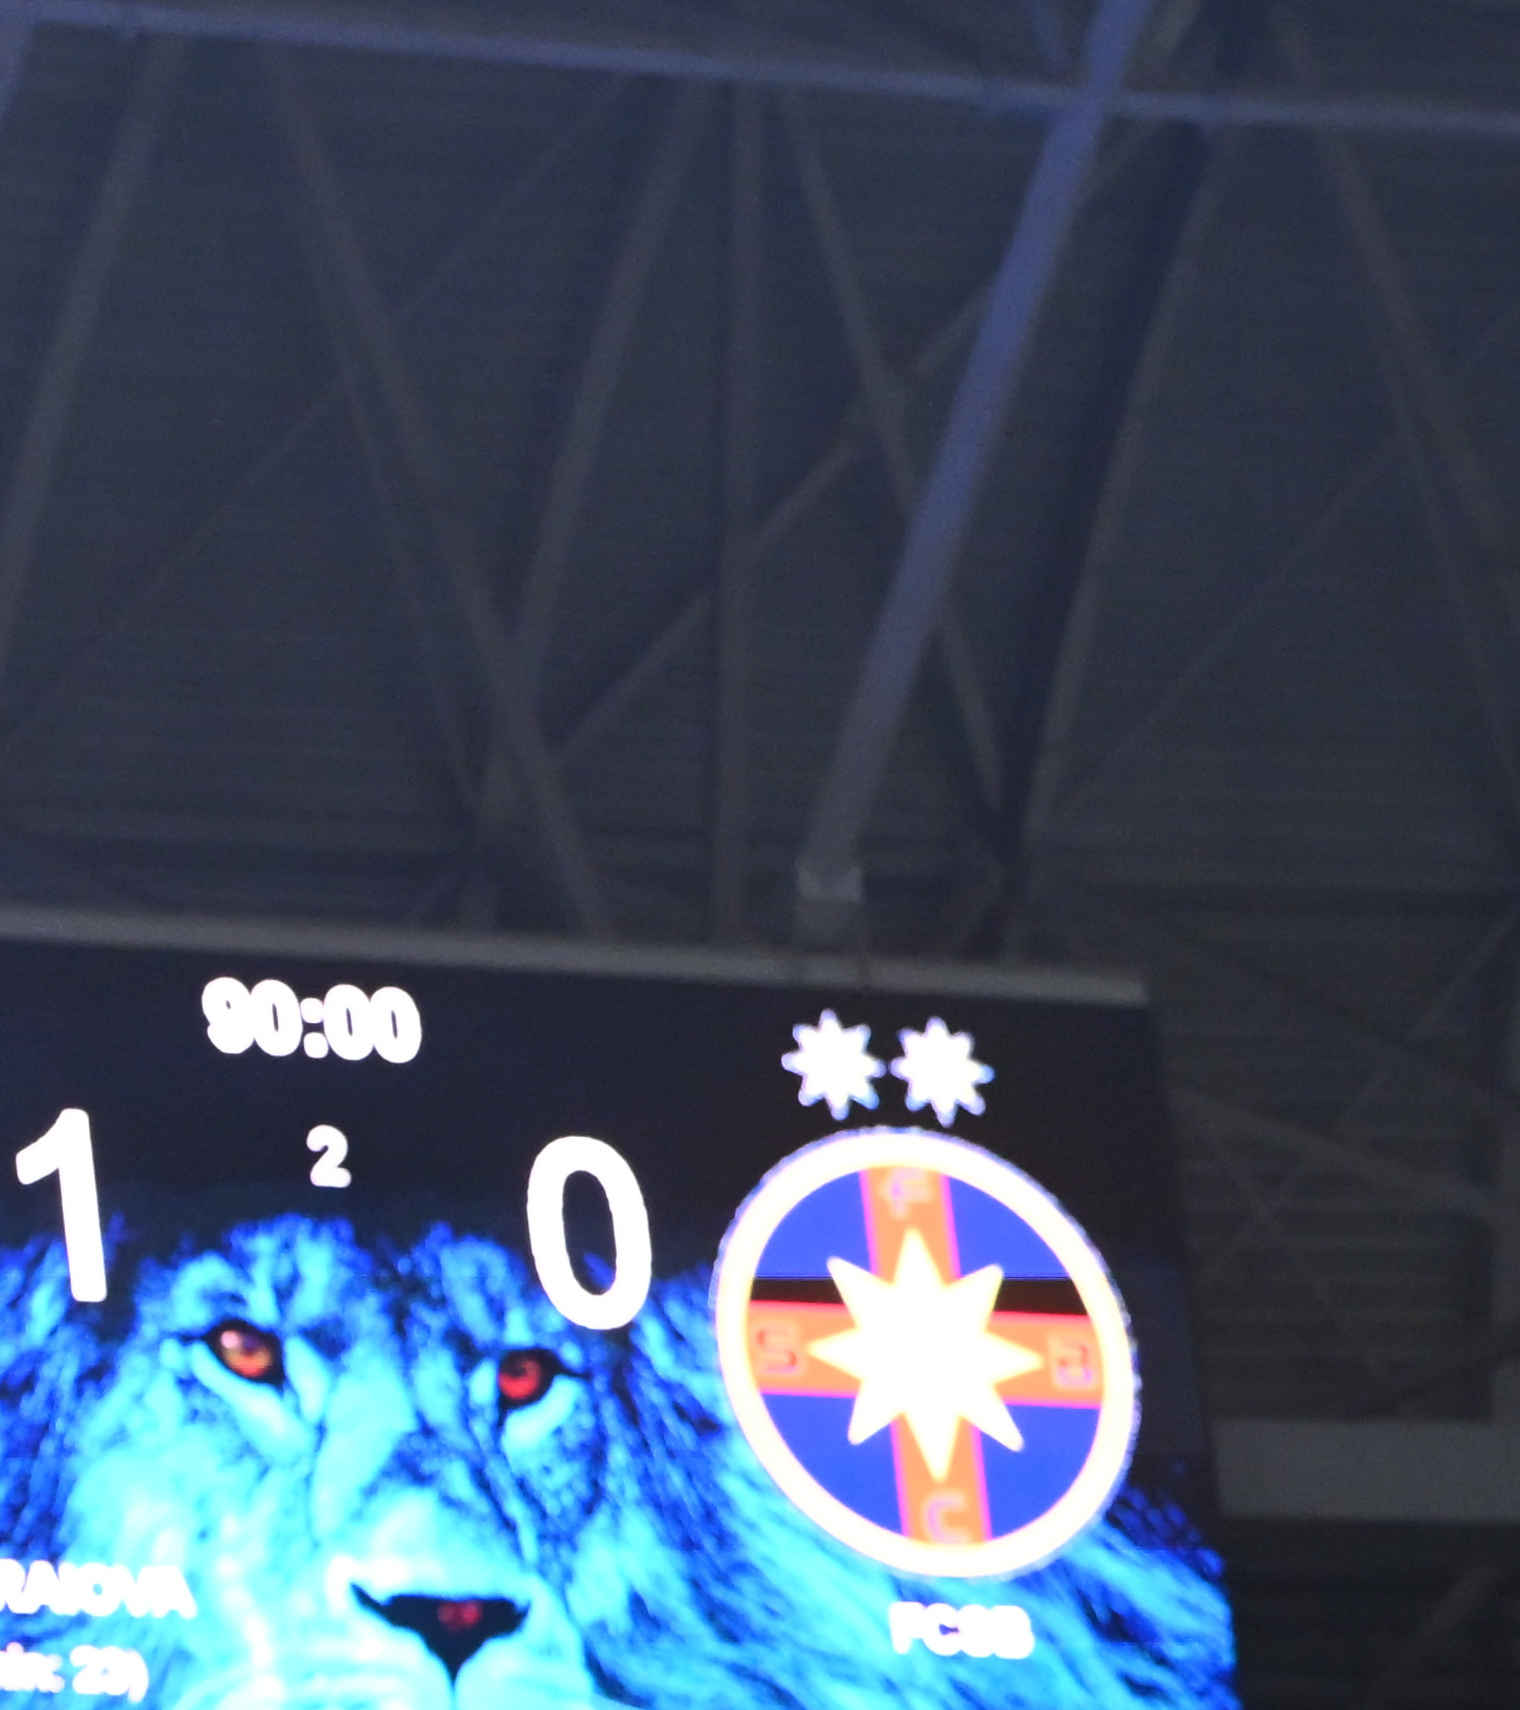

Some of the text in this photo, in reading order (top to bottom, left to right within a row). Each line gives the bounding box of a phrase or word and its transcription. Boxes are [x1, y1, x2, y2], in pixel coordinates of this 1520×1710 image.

[202, 977, 422, 1063] 90:00
[15, 1108, 107, 1302] 1
[306, 1125, 352, 1188] 2
[527, 1135, 653, 1331] 0
